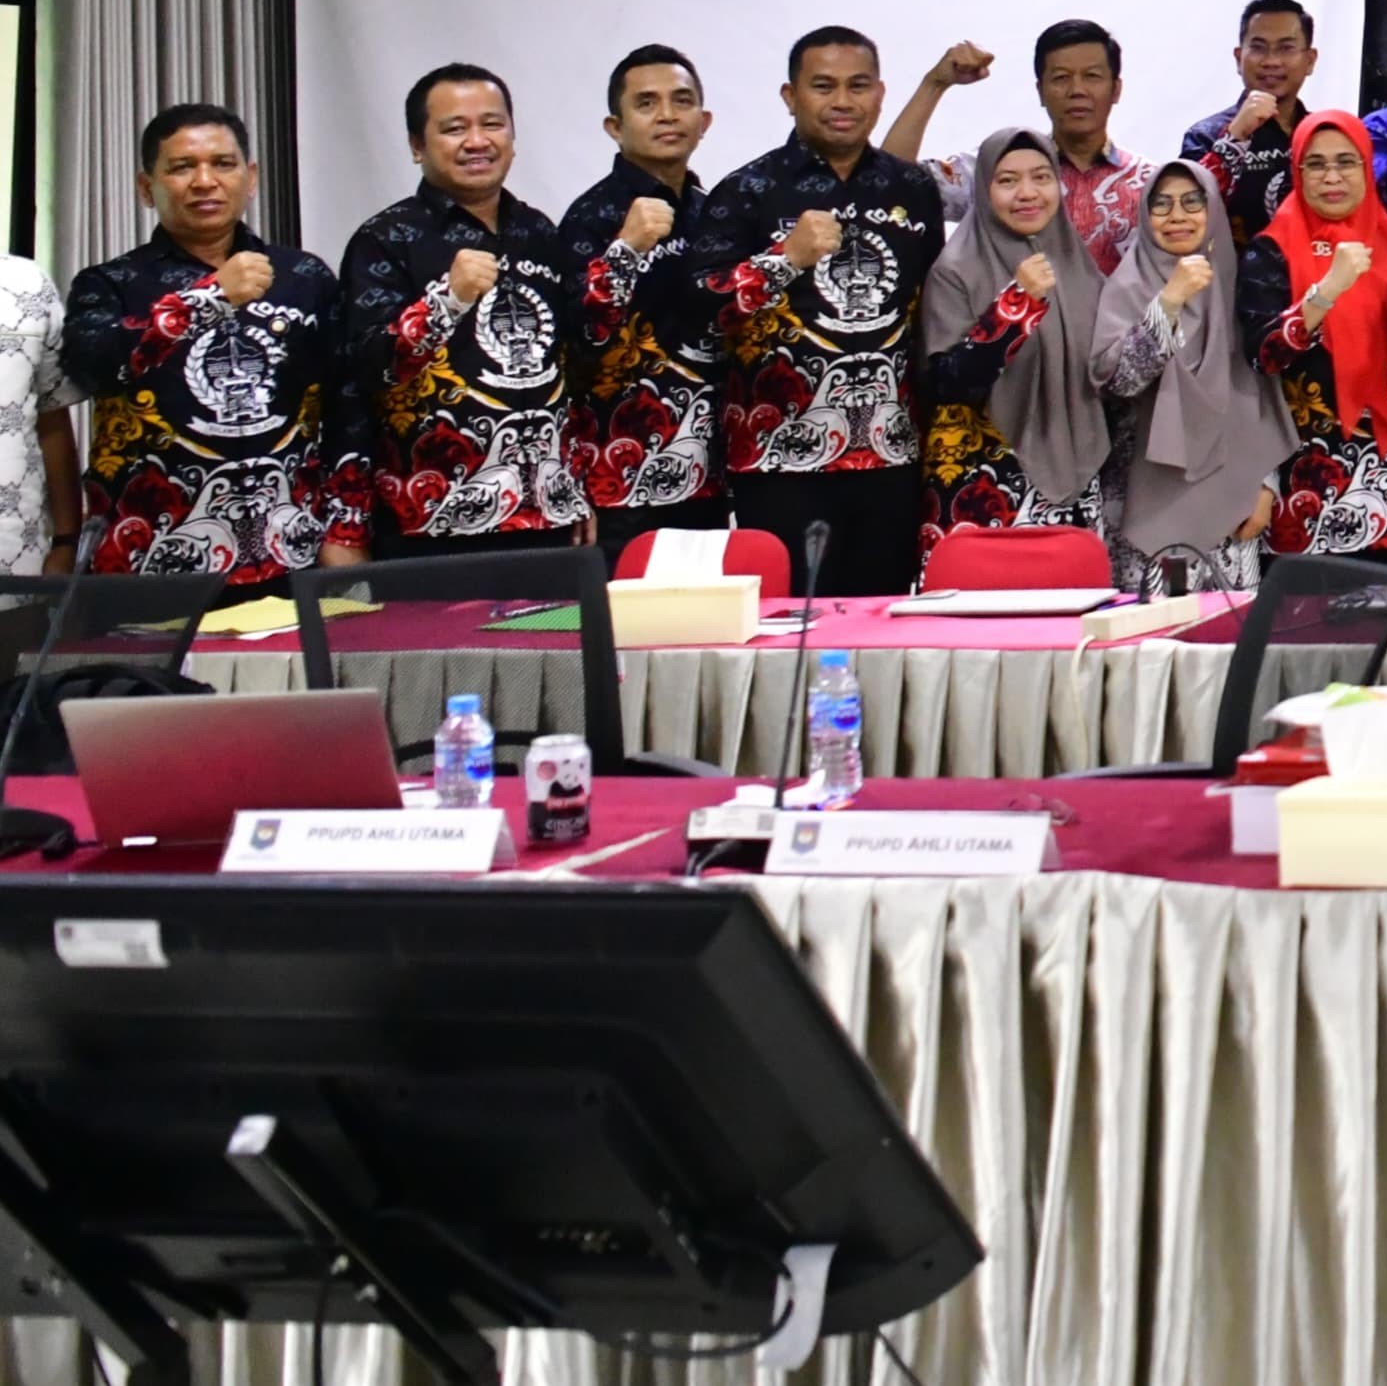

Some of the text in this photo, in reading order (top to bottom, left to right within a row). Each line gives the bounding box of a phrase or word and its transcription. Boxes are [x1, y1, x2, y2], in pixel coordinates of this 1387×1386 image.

[307, 825, 465, 840] PPUPD AHLI UTAMA
[845, 836, 1013, 852] PPUPD AHLI UTAMA
